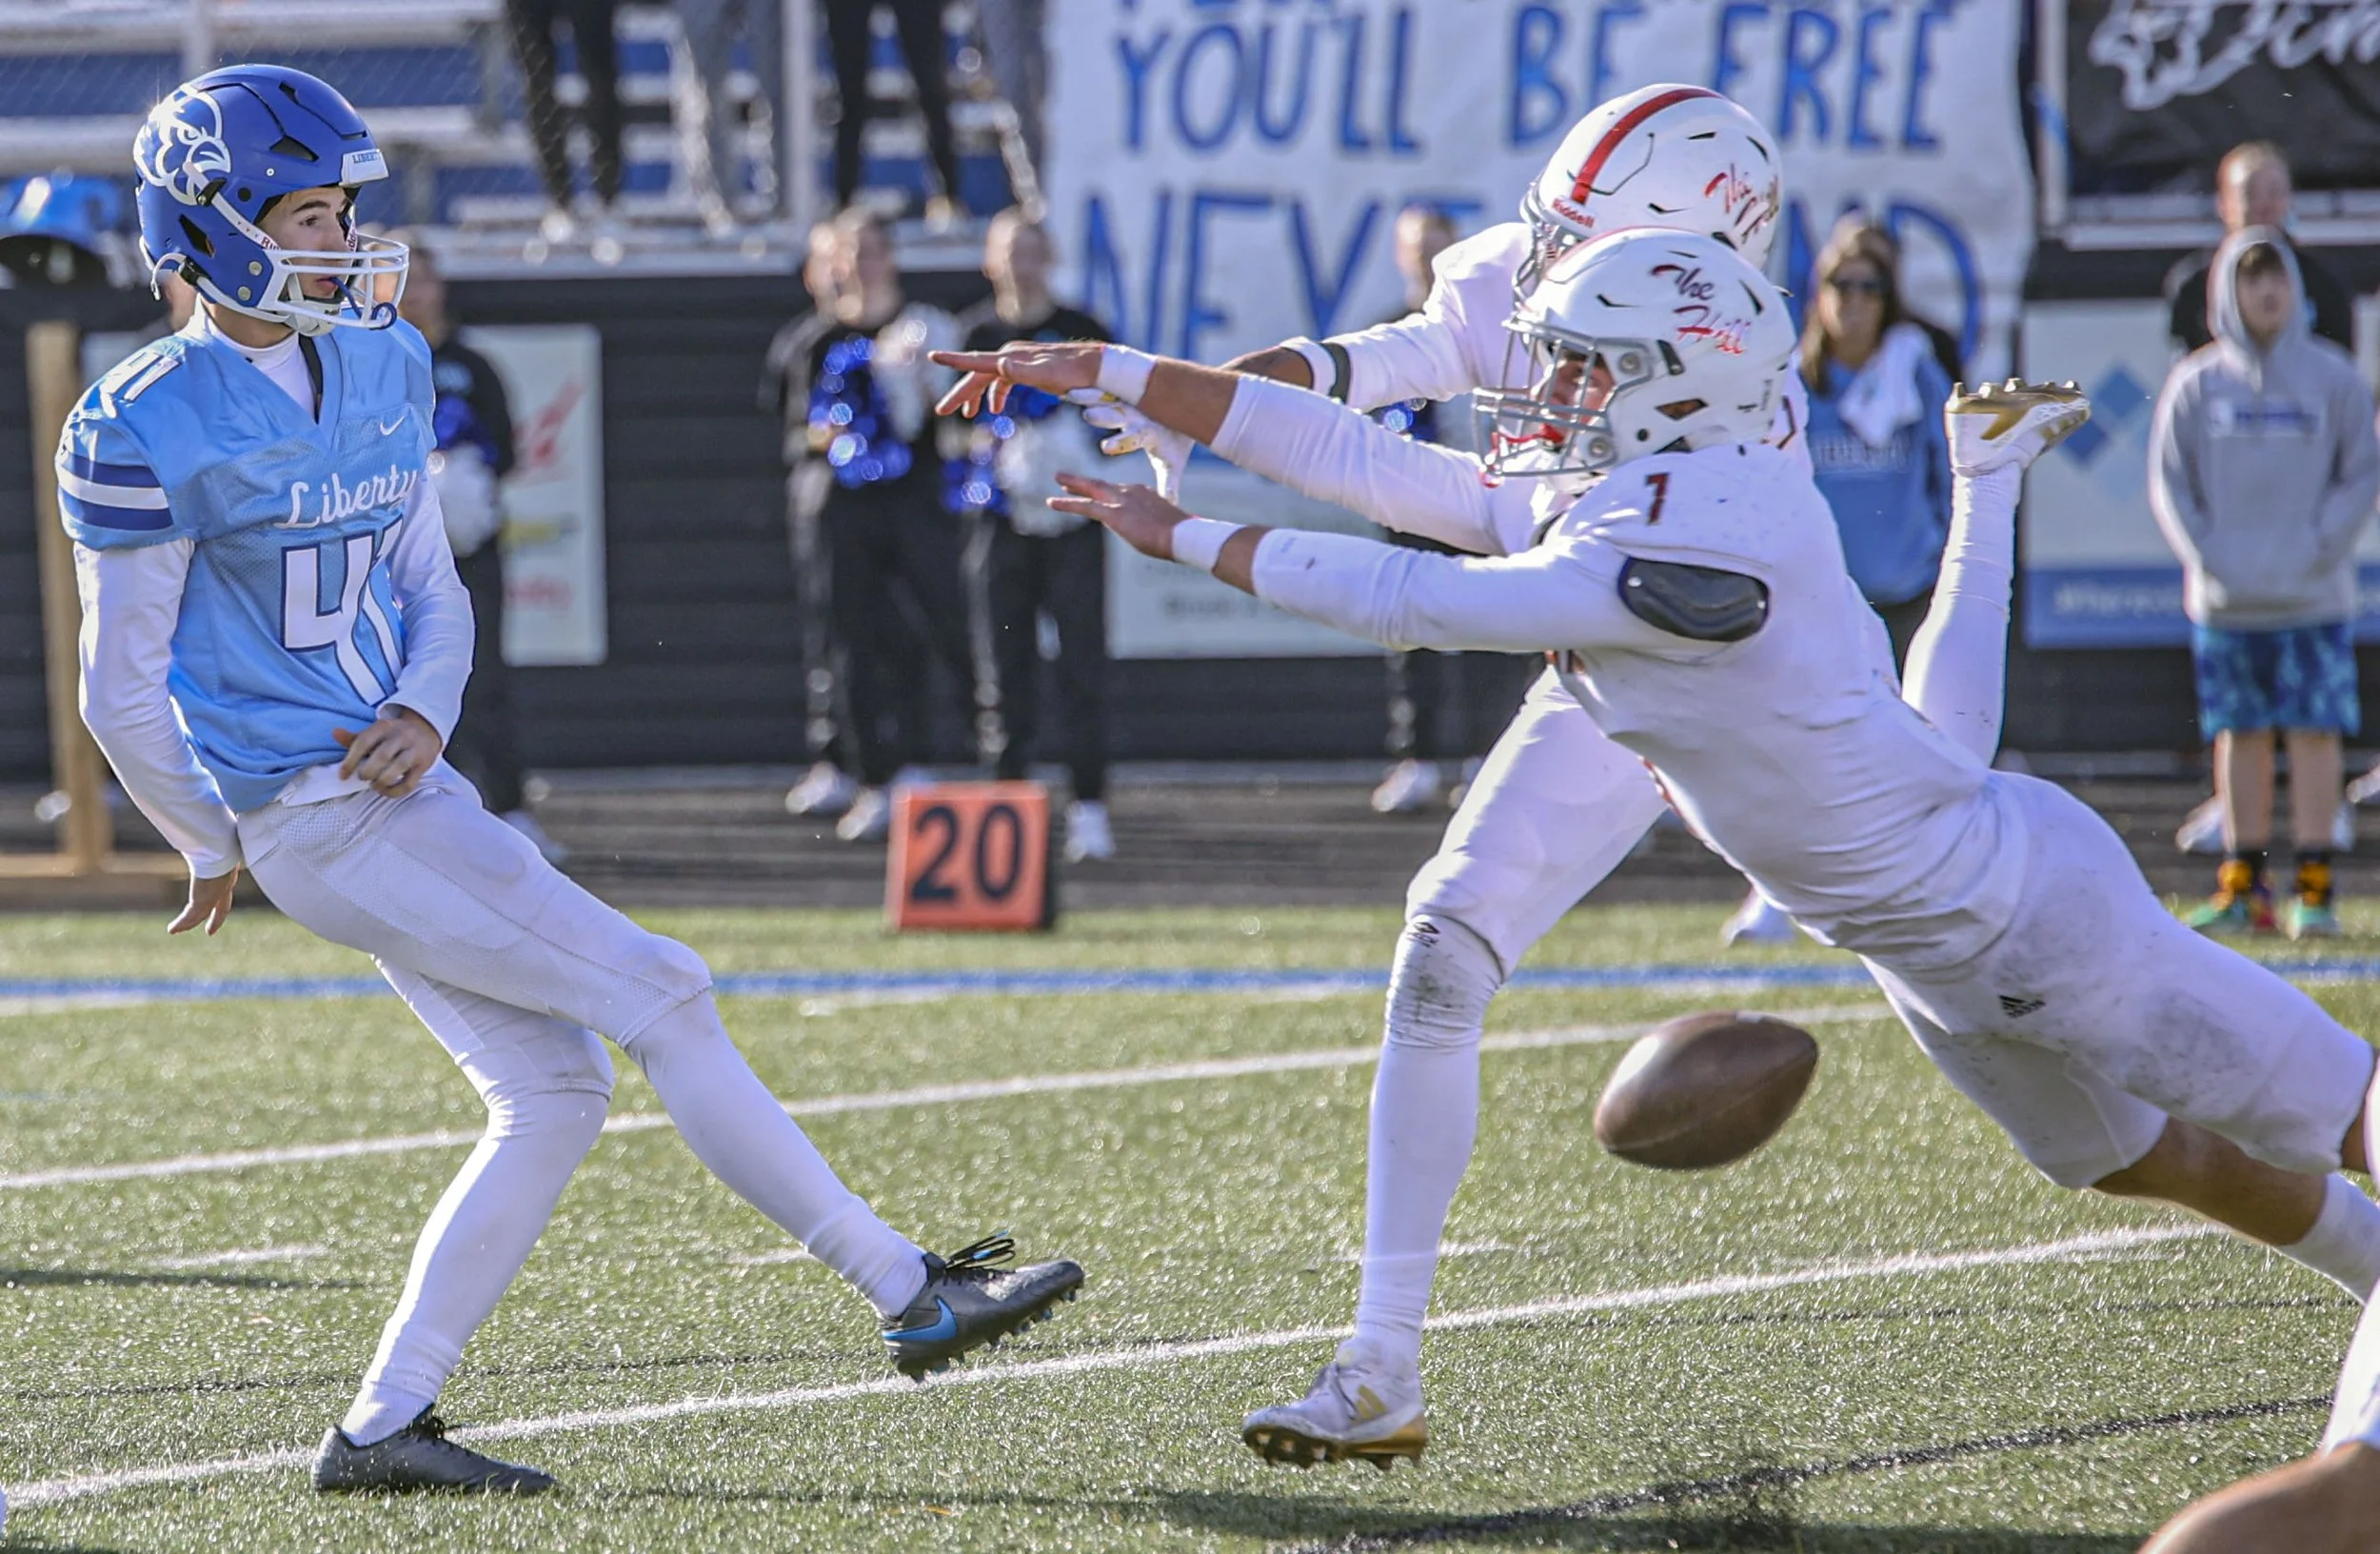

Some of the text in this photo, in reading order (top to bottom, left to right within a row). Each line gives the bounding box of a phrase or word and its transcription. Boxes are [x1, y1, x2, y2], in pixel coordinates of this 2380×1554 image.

[1650, 264, 1714, 301] The
[1673, 305, 1752, 355] Hill
[273, 464, 417, 529] Liberty
[911, 805, 1024, 905] 20
